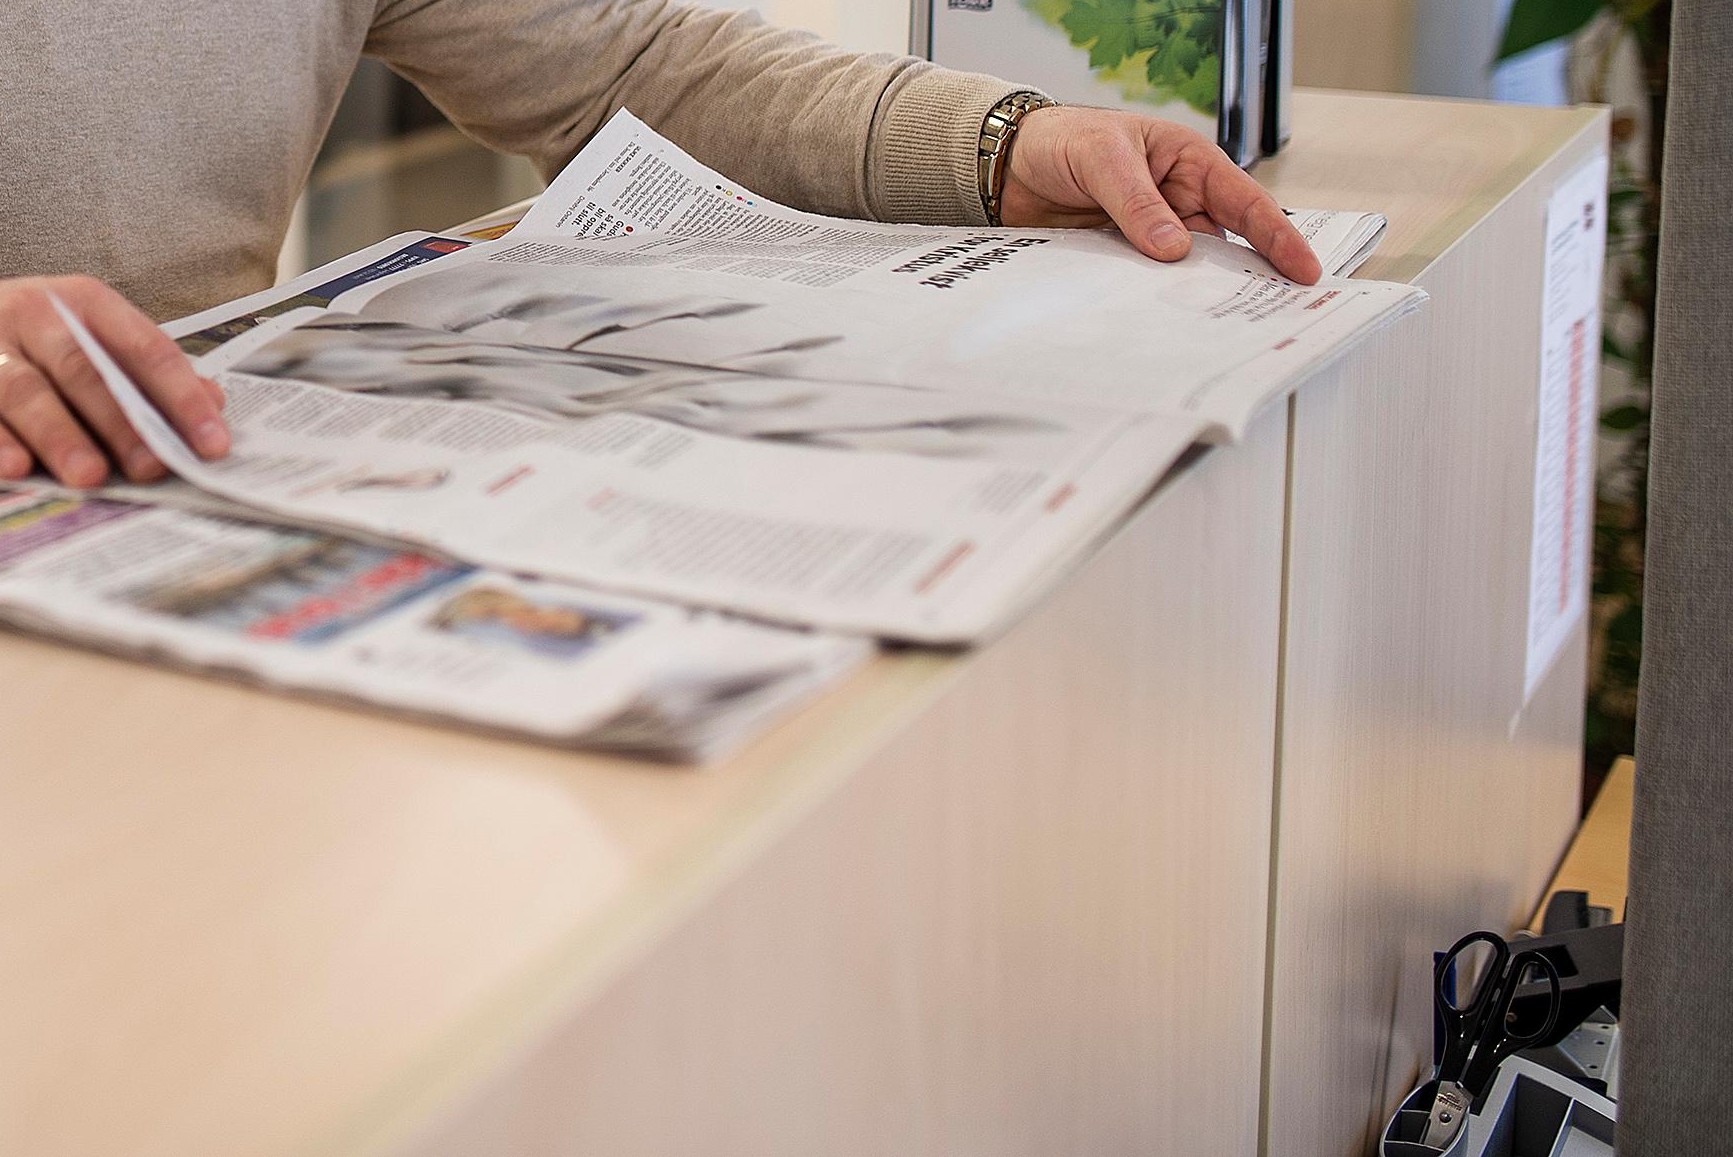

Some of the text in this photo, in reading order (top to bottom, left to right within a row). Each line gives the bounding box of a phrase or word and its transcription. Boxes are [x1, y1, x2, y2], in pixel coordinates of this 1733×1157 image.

[571, 202, 596, 225] til slutt.
[595, 208, 606, 219] bli
[605, 214, 614, 223] så
[958, 236, 1005, 246] for
[892, 246, 975, 273] Kristus
[919, 238, 1051, 289] En seljekvist
